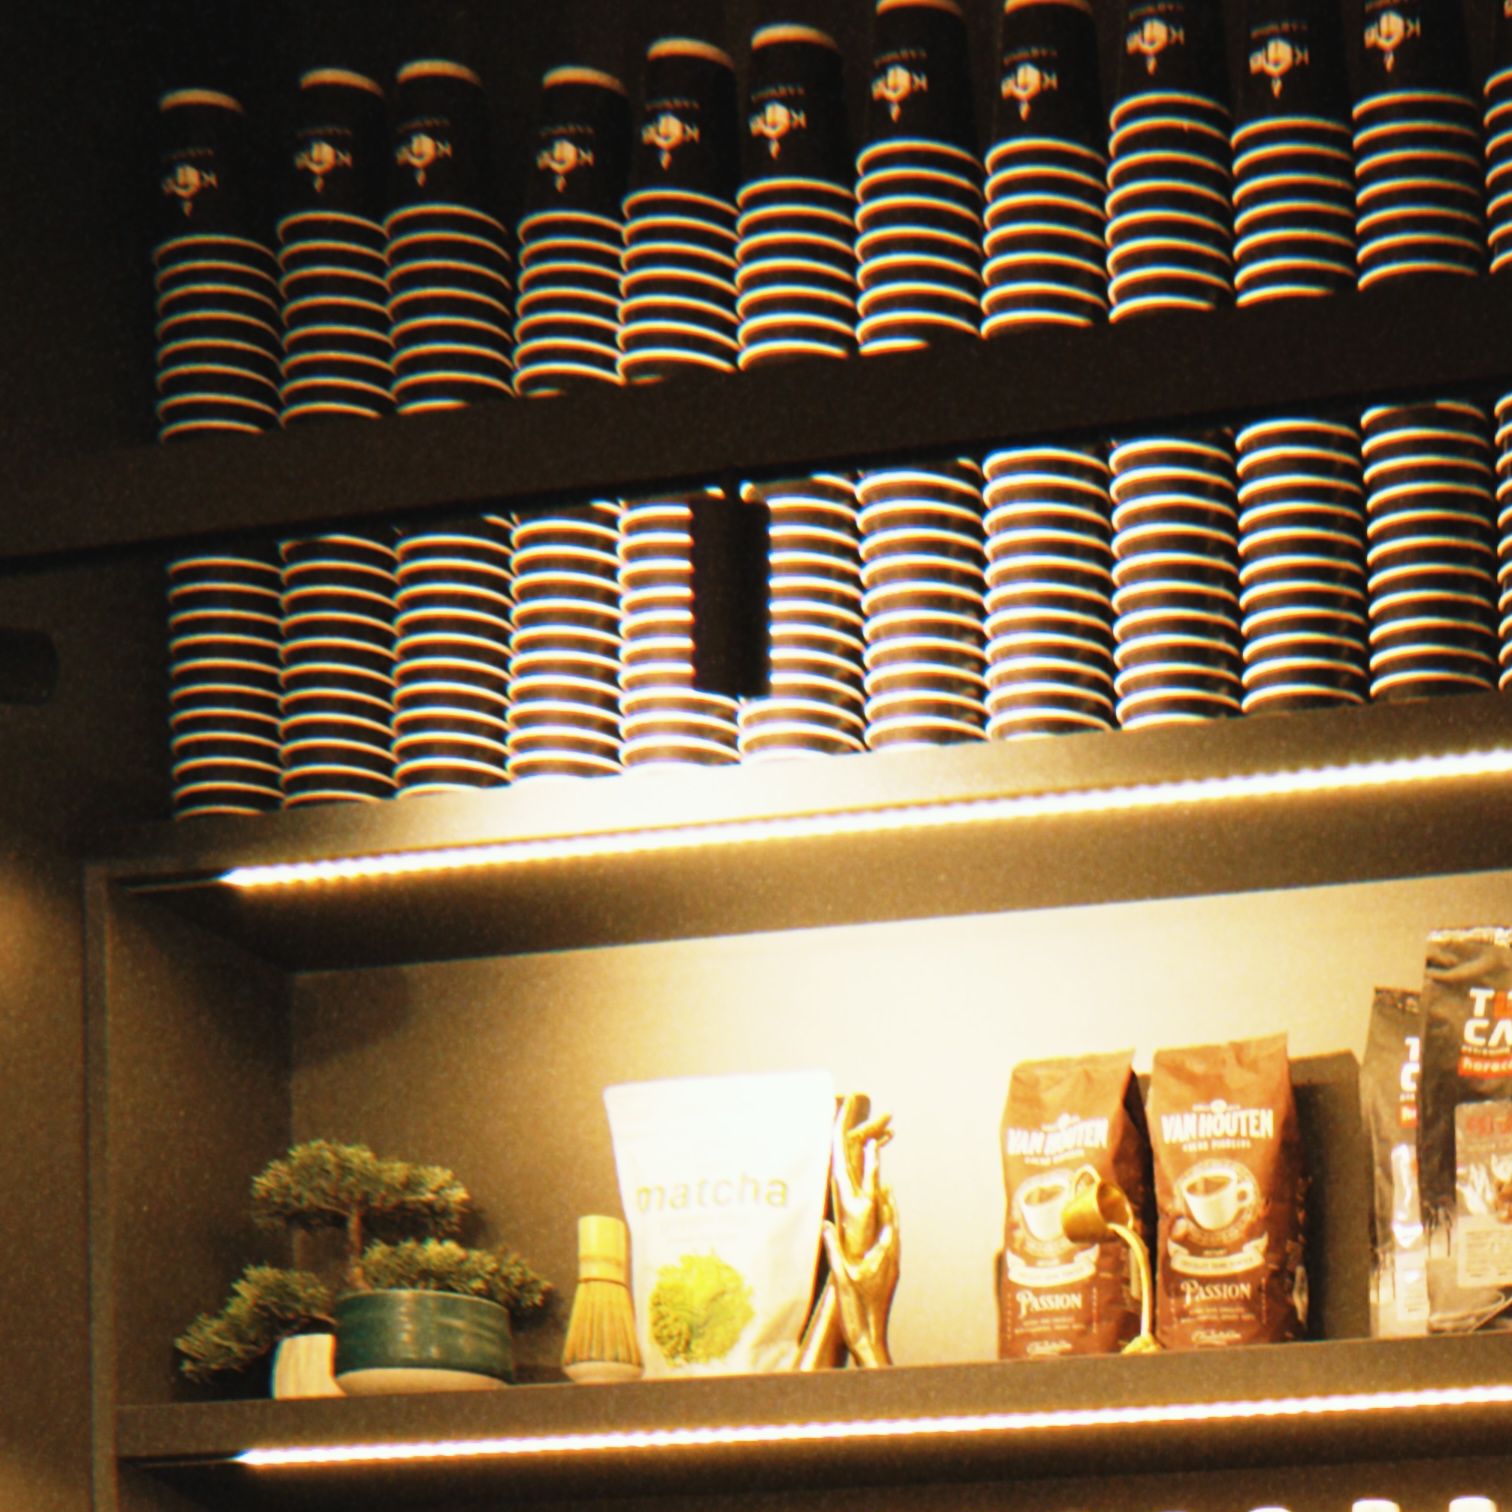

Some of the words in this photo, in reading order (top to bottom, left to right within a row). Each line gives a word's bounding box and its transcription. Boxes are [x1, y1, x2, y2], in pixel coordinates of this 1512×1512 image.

[1007, 1126, 1041, 1156] VAN
[1160, 1113, 1199, 1144] VAN
[1199, 1107, 1275, 1140] HOUTEN
[635, 1171, 790, 1213] matcha
